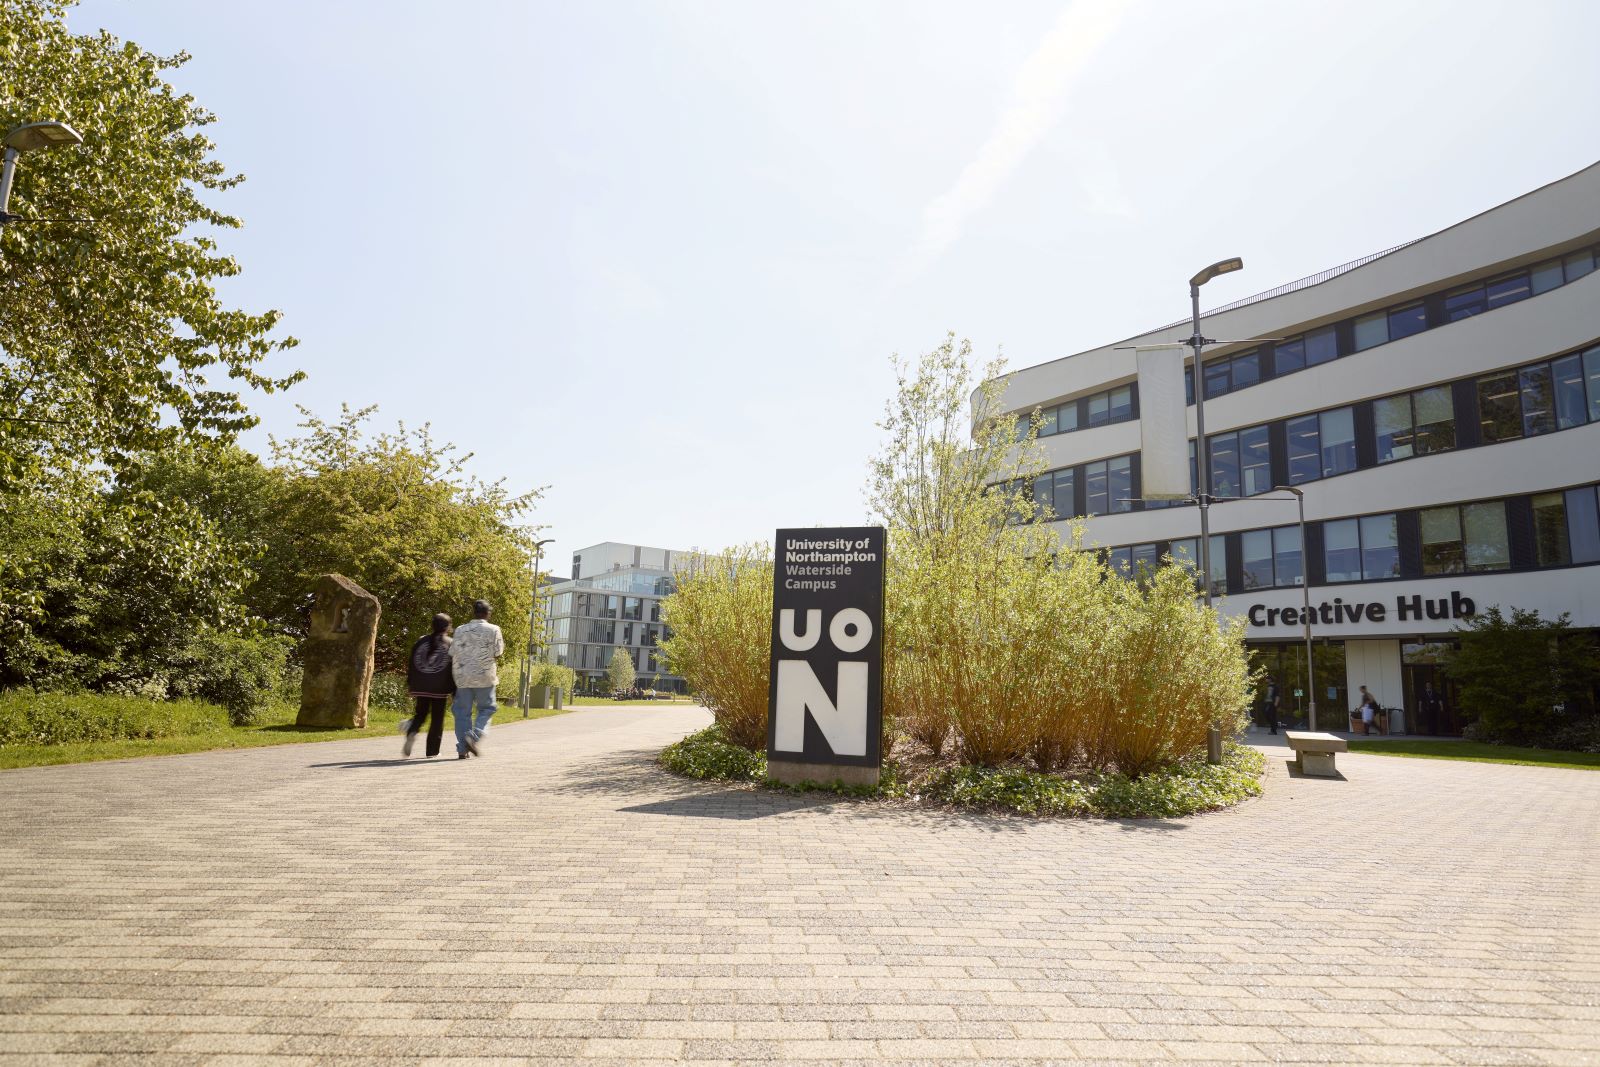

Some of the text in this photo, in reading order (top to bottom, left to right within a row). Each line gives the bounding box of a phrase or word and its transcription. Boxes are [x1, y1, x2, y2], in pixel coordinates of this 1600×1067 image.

[786, 537, 870, 552] University of
[785, 551, 876, 565] Northampton
[786, 564, 852, 576] Waterside
[785, 578, 837, 592] Campus
[1248, 590, 1476, 627] Creative Hub
